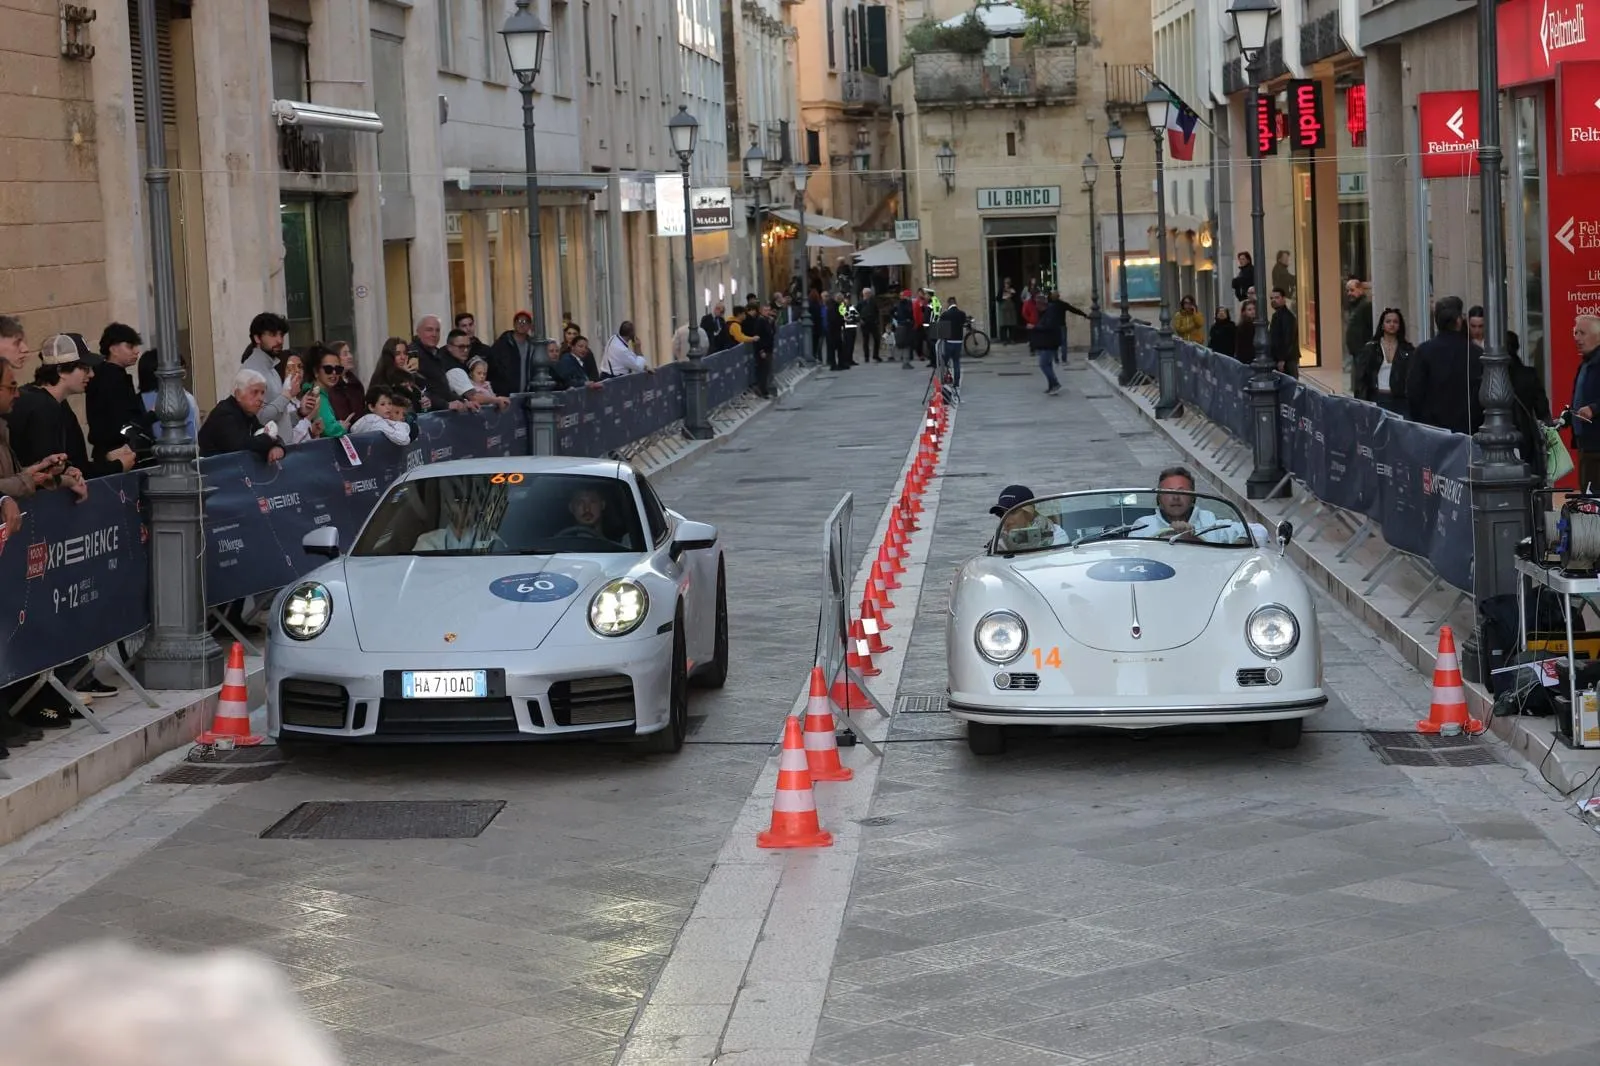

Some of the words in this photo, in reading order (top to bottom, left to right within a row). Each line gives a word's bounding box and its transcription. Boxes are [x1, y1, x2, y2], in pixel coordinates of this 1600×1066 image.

[1548, 3, 1586, 50] Feltrinelli
[1297, 85, 1321, 146] upim
[1428, 138, 1479, 154] Feltrinell
[988, 190, 1001, 206] IL
[1005, 188, 1051, 206] BANCO
[696, 216, 728, 225] MAGLIO
[1578, 220, 1600, 235] Fel
[490, 472, 525, 485] 60
[47, 525, 120, 571] XPERIENCE
[1115, 565, 1149, 574] 14
[516, 580, 555, 594] 60
[1031, 646, 1063, 671] 14
